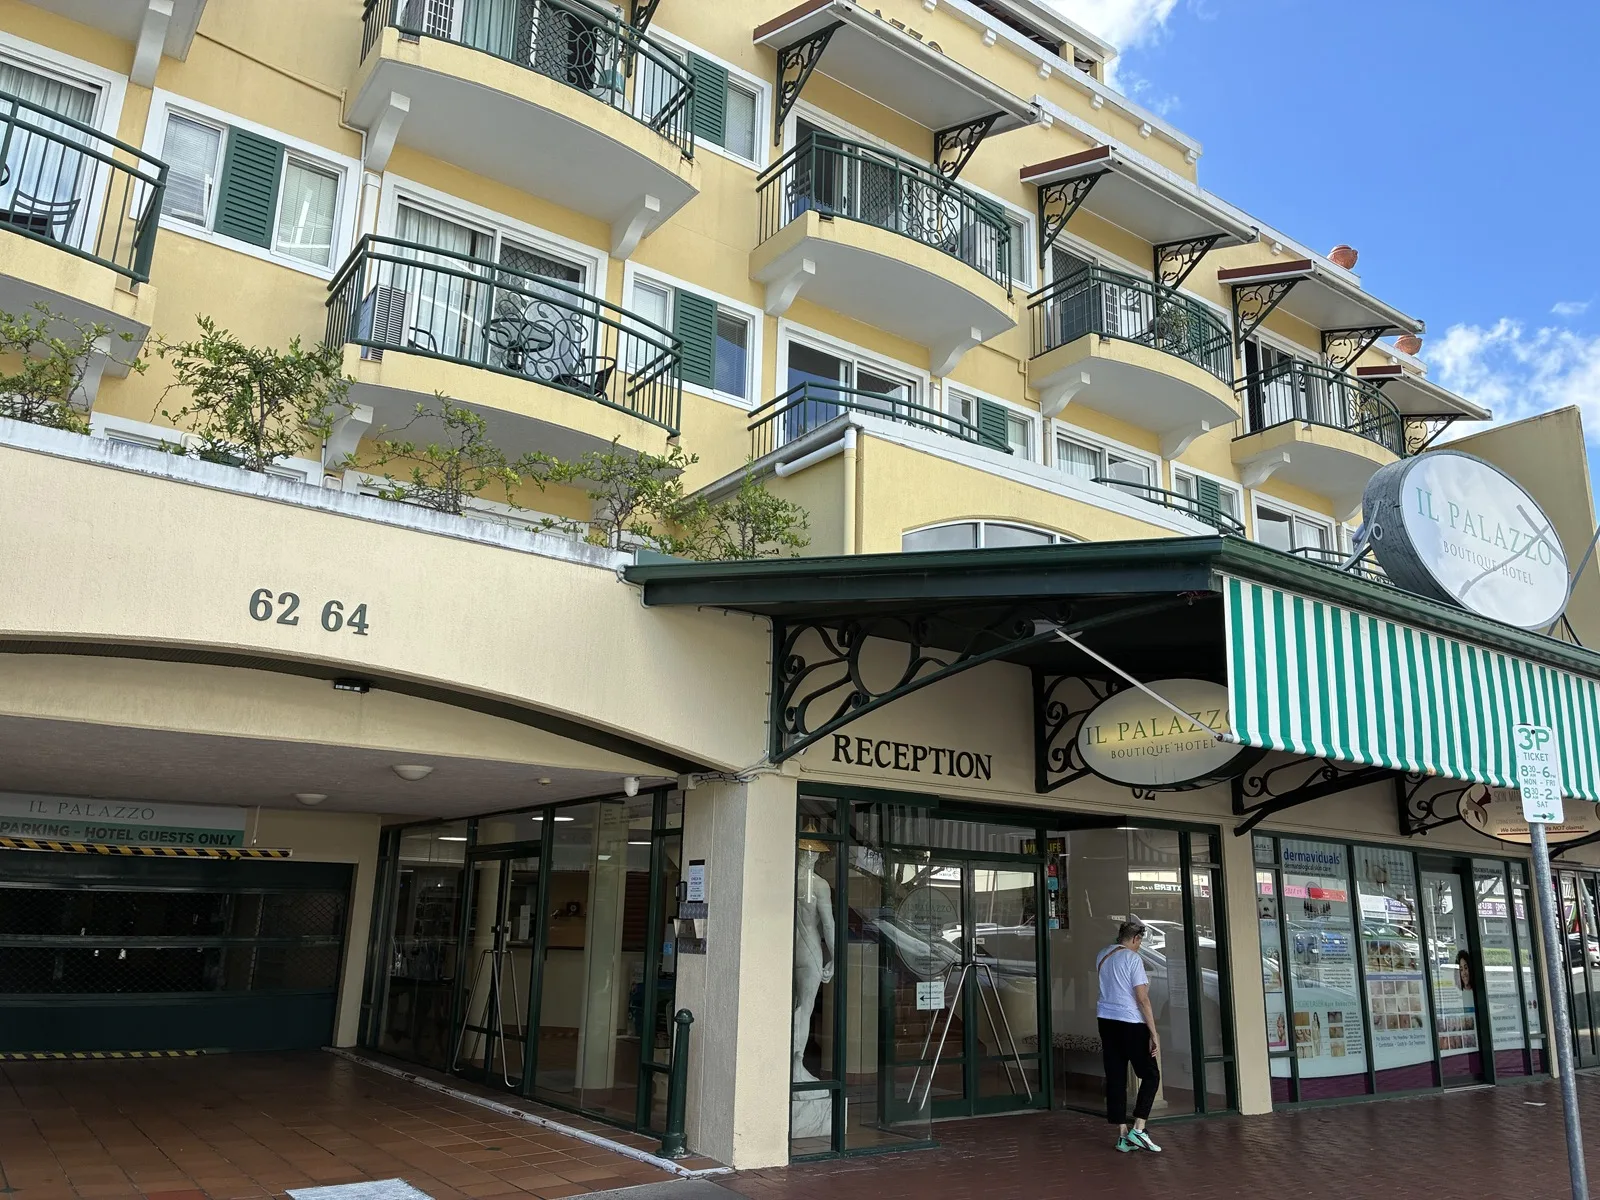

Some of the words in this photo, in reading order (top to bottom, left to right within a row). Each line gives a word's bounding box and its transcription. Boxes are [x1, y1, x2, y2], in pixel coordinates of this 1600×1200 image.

[1415, 487, 1440, 522] IL
[1447, 501, 1552, 566] PALAZZO
[1443, 540, 1498, 572] BOUTIQUE
[1501, 564, 1534, 586] HOTEL
[249, 588, 300, 626] 62
[321, 600, 369, 636] 64
[1086, 725, 1108, 746] IL
[1517, 727, 1550, 751] 3P
[832, 733, 992, 781] RECEPTION
[1111, 743, 1171, 759] BOUTIQUE
[1174, 739, 1216, 752] HOTEL
[1523, 752, 1549, 761] TICKET
[1523, 778, 1537, 786] MON
[29, 800, 48, 813] IL
[57, 802, 156, 821] PALAZZO
[1536, 800, 1549, 808] SAT
[0, 821, 70, 837] PARKING
[84, 826, 134, 841] HOTEL
[138, 829, 195, 844] GUESTS
[198, 832, 236, 846] ONLY
[1283, 847, 1341, 865] dermaviduals
